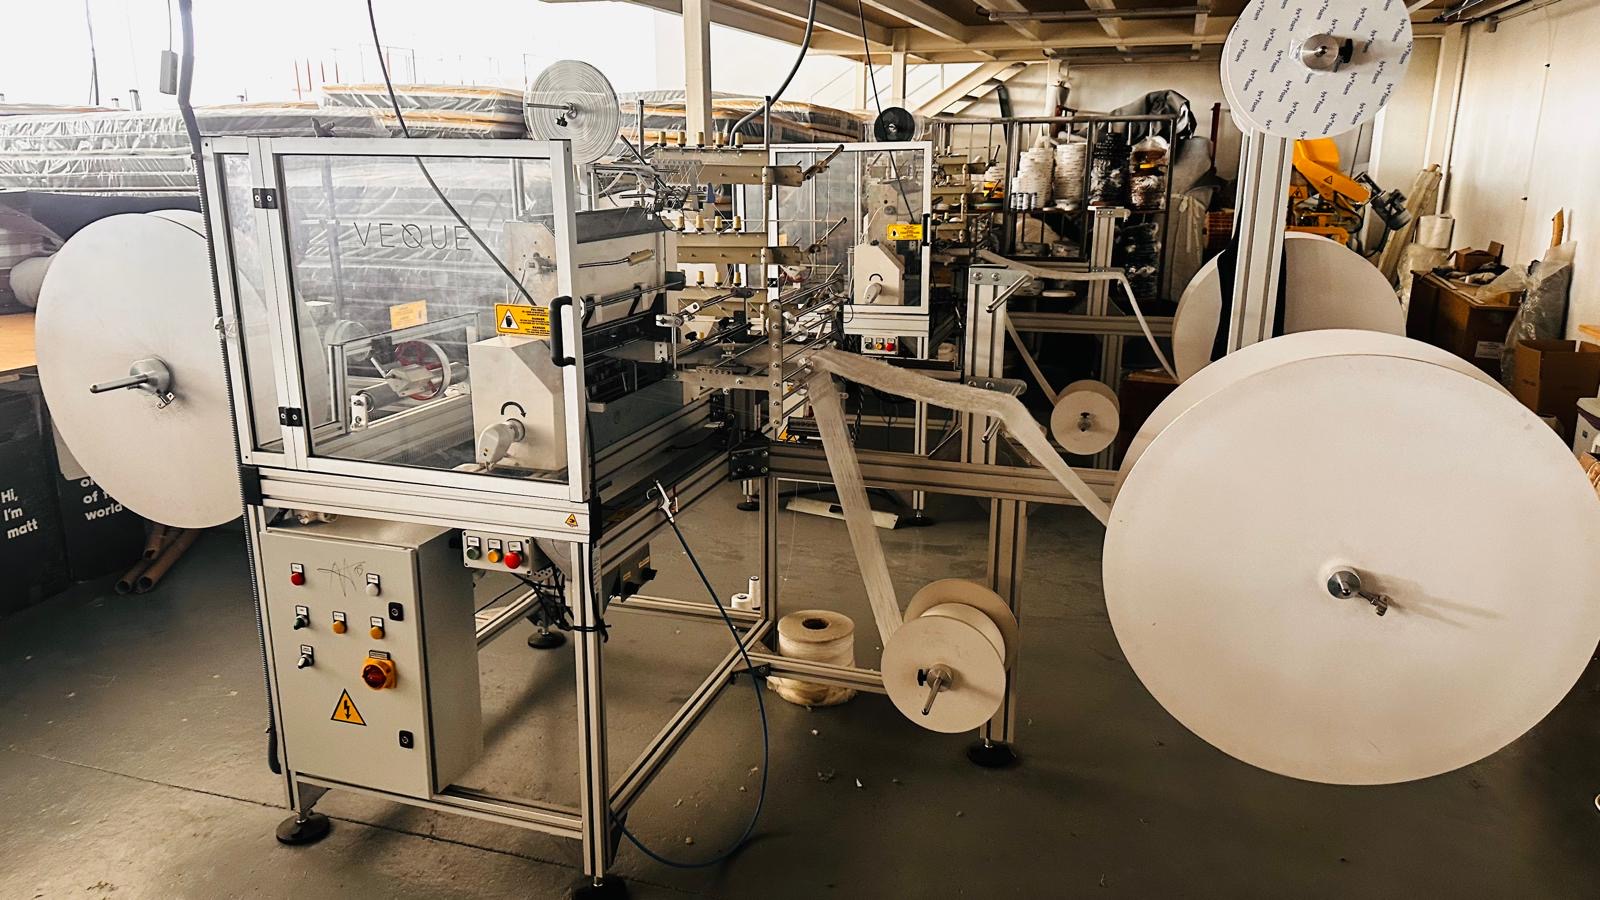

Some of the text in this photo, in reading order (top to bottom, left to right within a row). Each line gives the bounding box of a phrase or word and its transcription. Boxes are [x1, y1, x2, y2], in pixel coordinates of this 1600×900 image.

[353, 222, 472, 251] VEQUE
[1, 488, 18, 503] Hi,
[83, 491, 98, 504] of
[4, 507, 23, 521] I'm
[7, 518, 38, 539] matt
